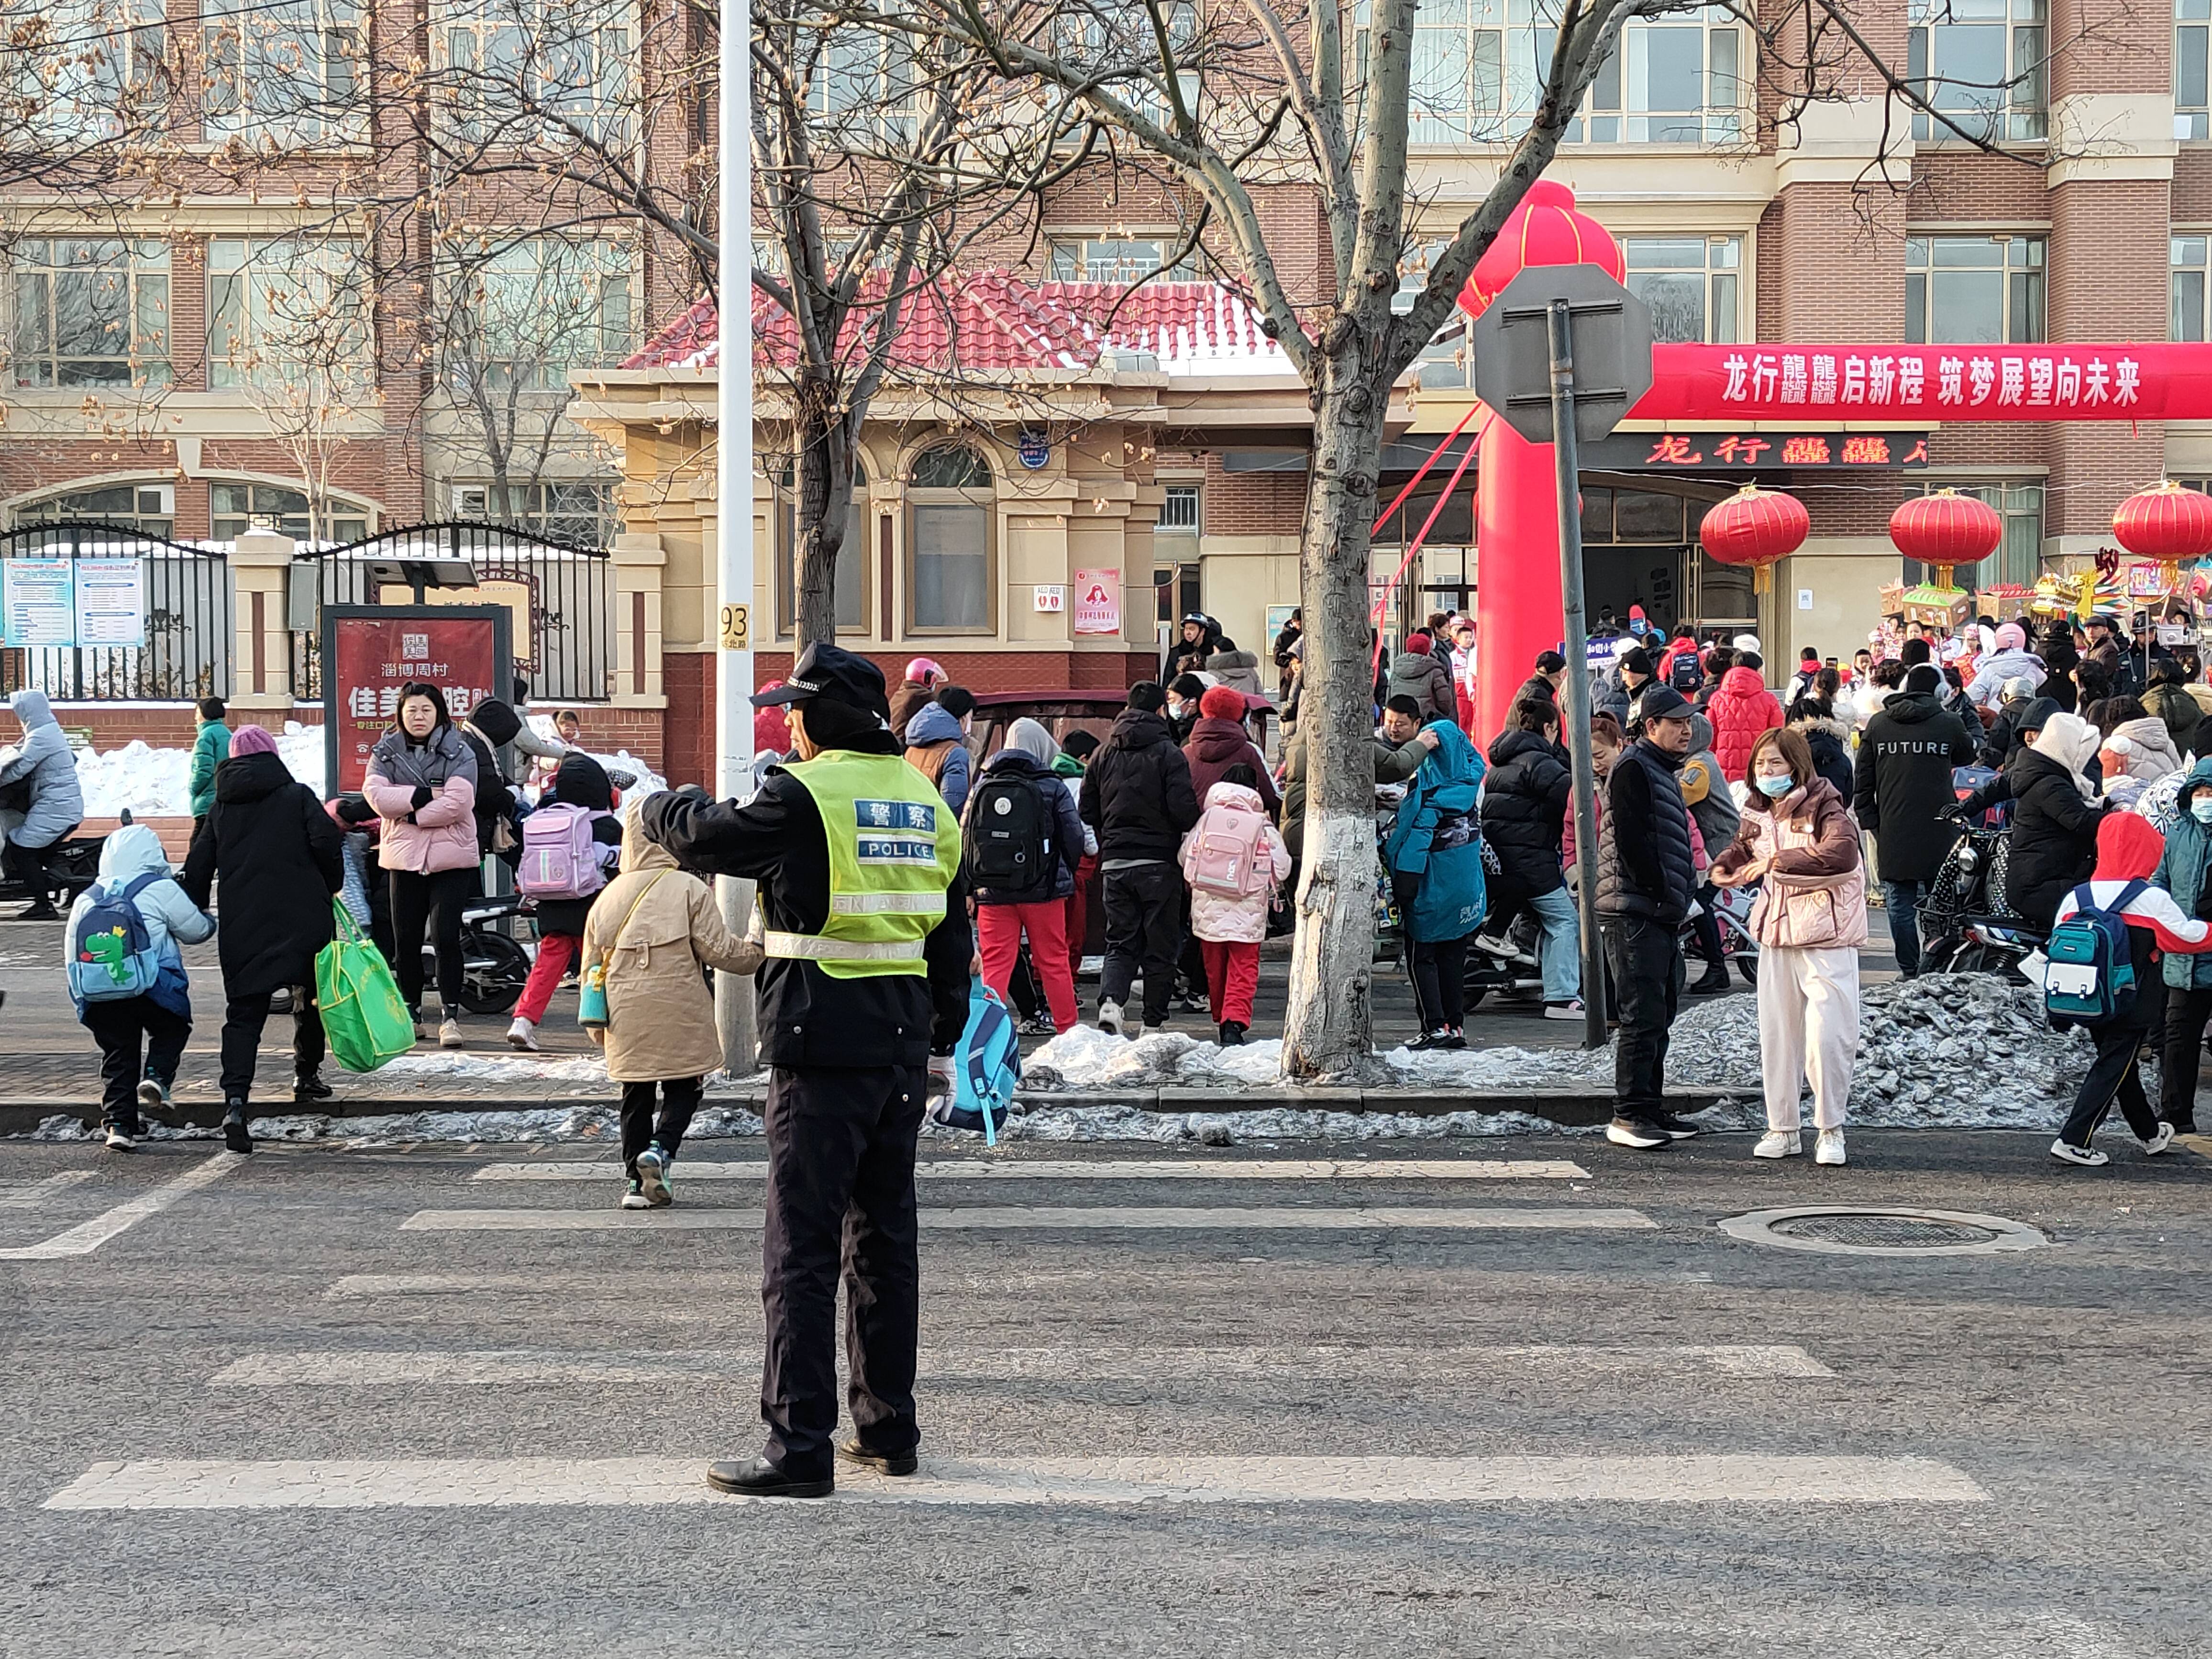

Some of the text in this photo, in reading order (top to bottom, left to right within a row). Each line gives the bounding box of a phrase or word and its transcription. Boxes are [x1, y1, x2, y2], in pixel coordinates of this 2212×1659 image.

[1722, 353, 2140, 407] 龙行龘龘启新程 筑梦展望向未来
[721, 607, 747, 636] 93
[381, 663, 449, 677] 淄博周村
[348, 686, 470, 718] 佳美腔
[1877, 741, 1949, 756] FUTURE
[869, 803, 926, 828] 警察
[868, 843, 930, 858] POLICE
